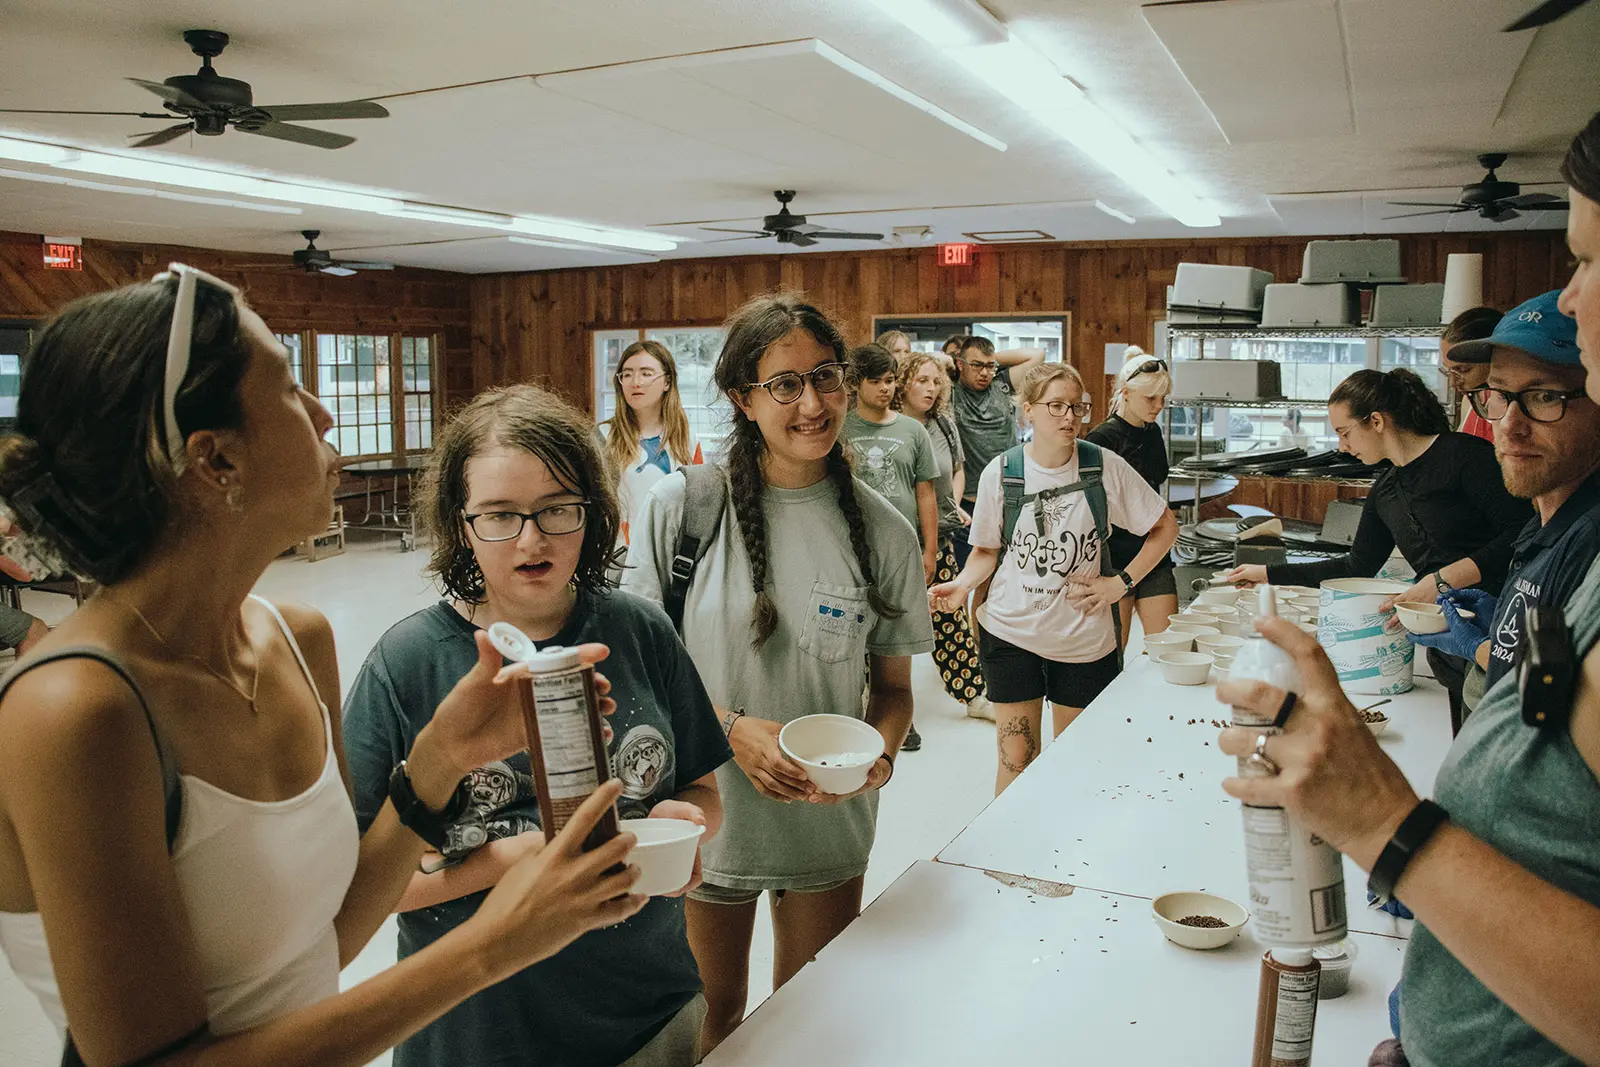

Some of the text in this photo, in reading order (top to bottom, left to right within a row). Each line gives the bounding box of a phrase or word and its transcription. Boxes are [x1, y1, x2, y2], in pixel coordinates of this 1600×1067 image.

[50, 244, 75, 268] EXIT
[944, 245, 968, 264] EXIT
[1519, 311, 1542, 323] OR
[1491, 644, 1514, 663] 2024
